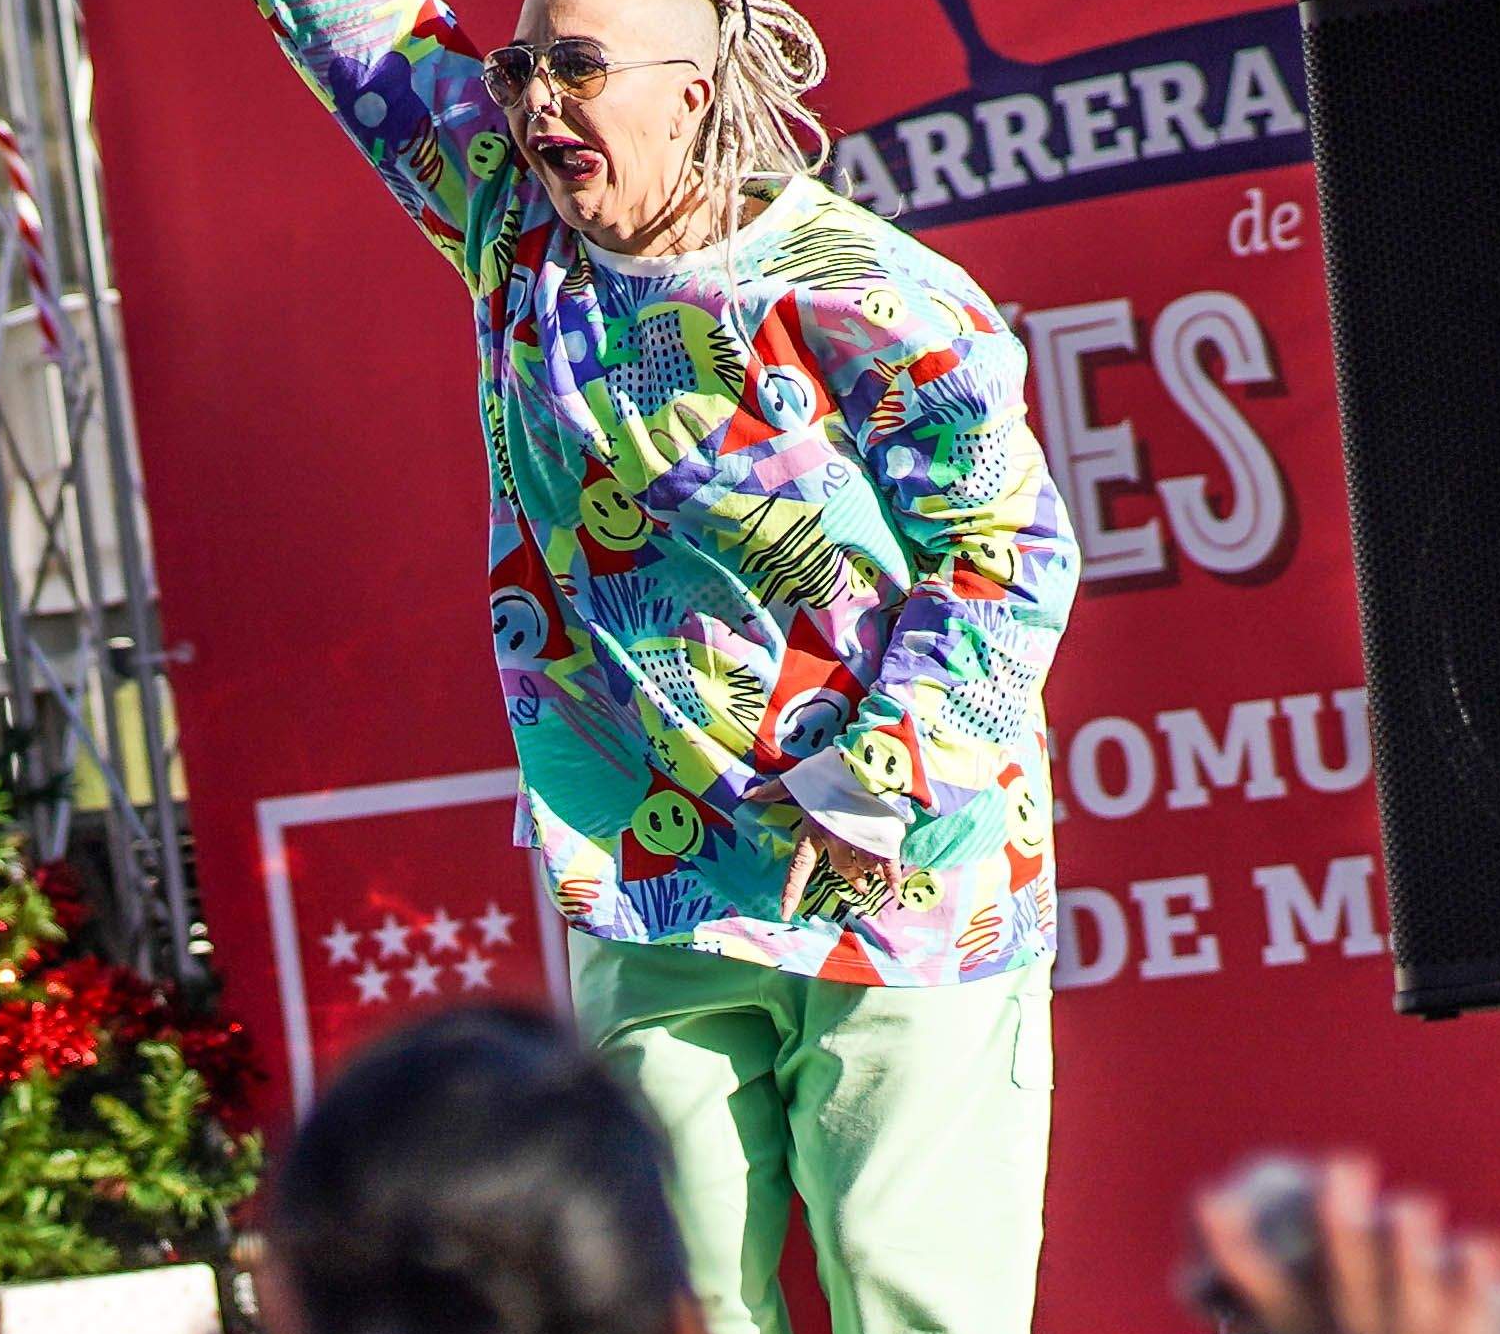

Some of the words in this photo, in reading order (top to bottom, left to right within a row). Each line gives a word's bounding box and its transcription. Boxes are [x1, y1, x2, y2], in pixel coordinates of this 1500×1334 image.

[834, 45, 1306, 217] ARRERA
[1228, 187, 1304, 257] de
[1004, 289, 1285, 583] ES
[1048, 686, 1376, 824] OMU
[1052, 873, 1221, 990] DE
[1252, 854, 1394, 966] M
